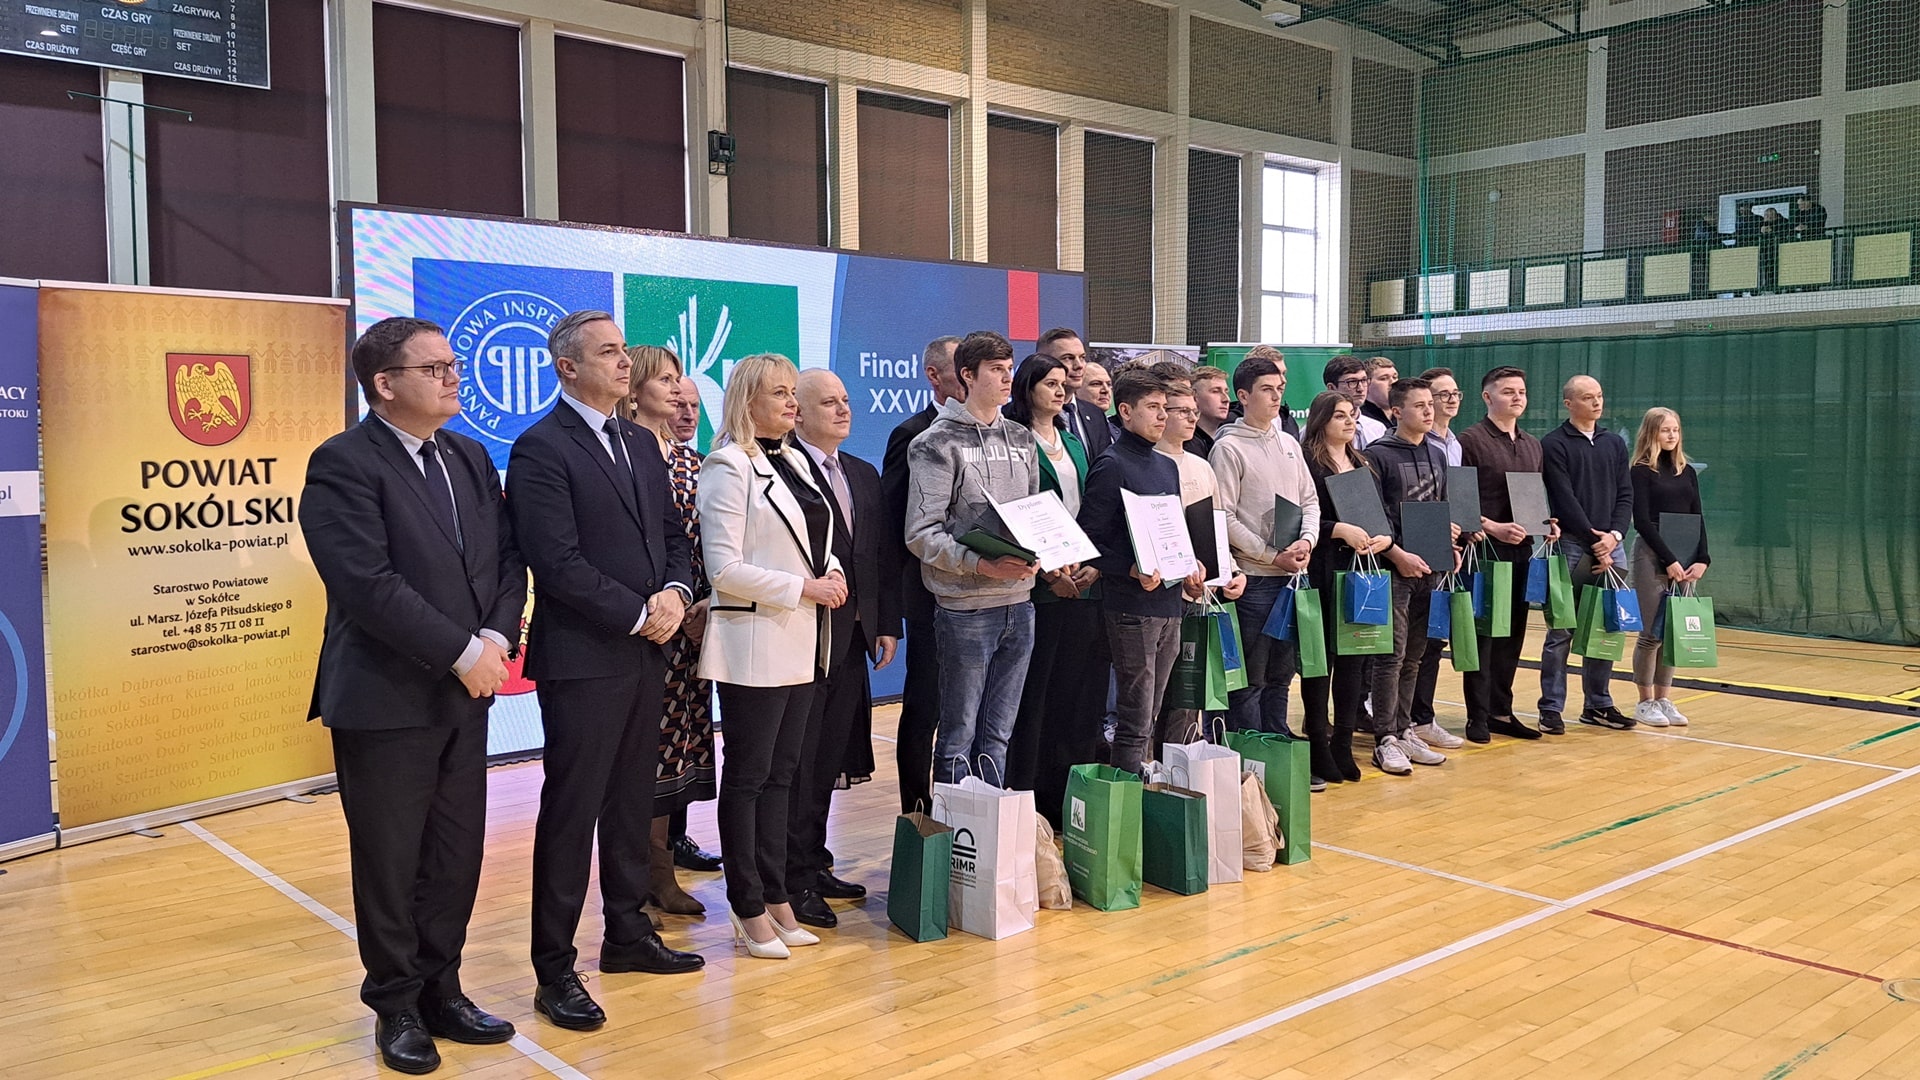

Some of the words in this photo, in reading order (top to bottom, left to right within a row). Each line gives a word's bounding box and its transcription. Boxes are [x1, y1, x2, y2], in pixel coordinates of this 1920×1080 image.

[101, 7, 129, 20] CZAS
[131, 11, 152, 24] GRY
[172, 4, 222, 20] ZAGRYWKA
[60, 24, 77, 34] SET
[25, 40, 44, 50] CZAS
[46, 44, 80, 56] DRUŻYNY
[111, 42, 132, 55] CZĘŚĆ
[134, 46, 147, 56] GRY
[176, 42, 192, 52] SET
[174, 62, 192, 72] CZAS
[192, 64, 222, 76] DRUŻYNY
[860, 352, 918, 379] Finał
[140, 458, 278, 489] POWIAT
[121, 493, 294, 534] SOKÓLSKI
[128, 533, 288, 556] www.sokolka-powiat.pl
[154, 582, 210, 595] Starostwo
[212, 576, 268, 590] Powiatowe
[186, 598, 195, 606] w
[198, 592, 240, 605] Sokółce
[130, 616, 144, 627] ul.
[148, 614, 182, 625] Marsz.
[186, 607, 218, 622] Józefa
[220, 601, 284, 616] Piłsudskiego
[286, 600, 292, 609] 8
[163, 626, 180, 638] tel.
[183, 624, 202, 636] +48
[204, 622, 218, 632] 85
[220, 620, 236, 632] 711
[239, 618, 252, 628] 08
[255, 617, 264, 626] 11
[131, 626, 290, 657] starostwo@sokolka-powiat.pl
[122, 674, 182, 694] Dąbrowa
[187, 660, 258, 682] Białostocka
[265, 650, 302, 668] Krynki
[140, 692, 174, 708] Sidra
[245, 674, 280, 690] Janów
[288, 668, 315, 682] Kory
[106, 714, 159, 733] Sokółka
[234, 686, 301, 708] Białostocka
[155, 718, 224, 741] Suchowola
[240, 710, 270, 724] Sidra
[200, 730, 248, 750] Sokółka
[210, 742, 275, 765] Suchowola
[282, 735, 312, 748] Sidra
[61, 800, 101, 815] anów
[951, 857, 976, 874] RiMR
